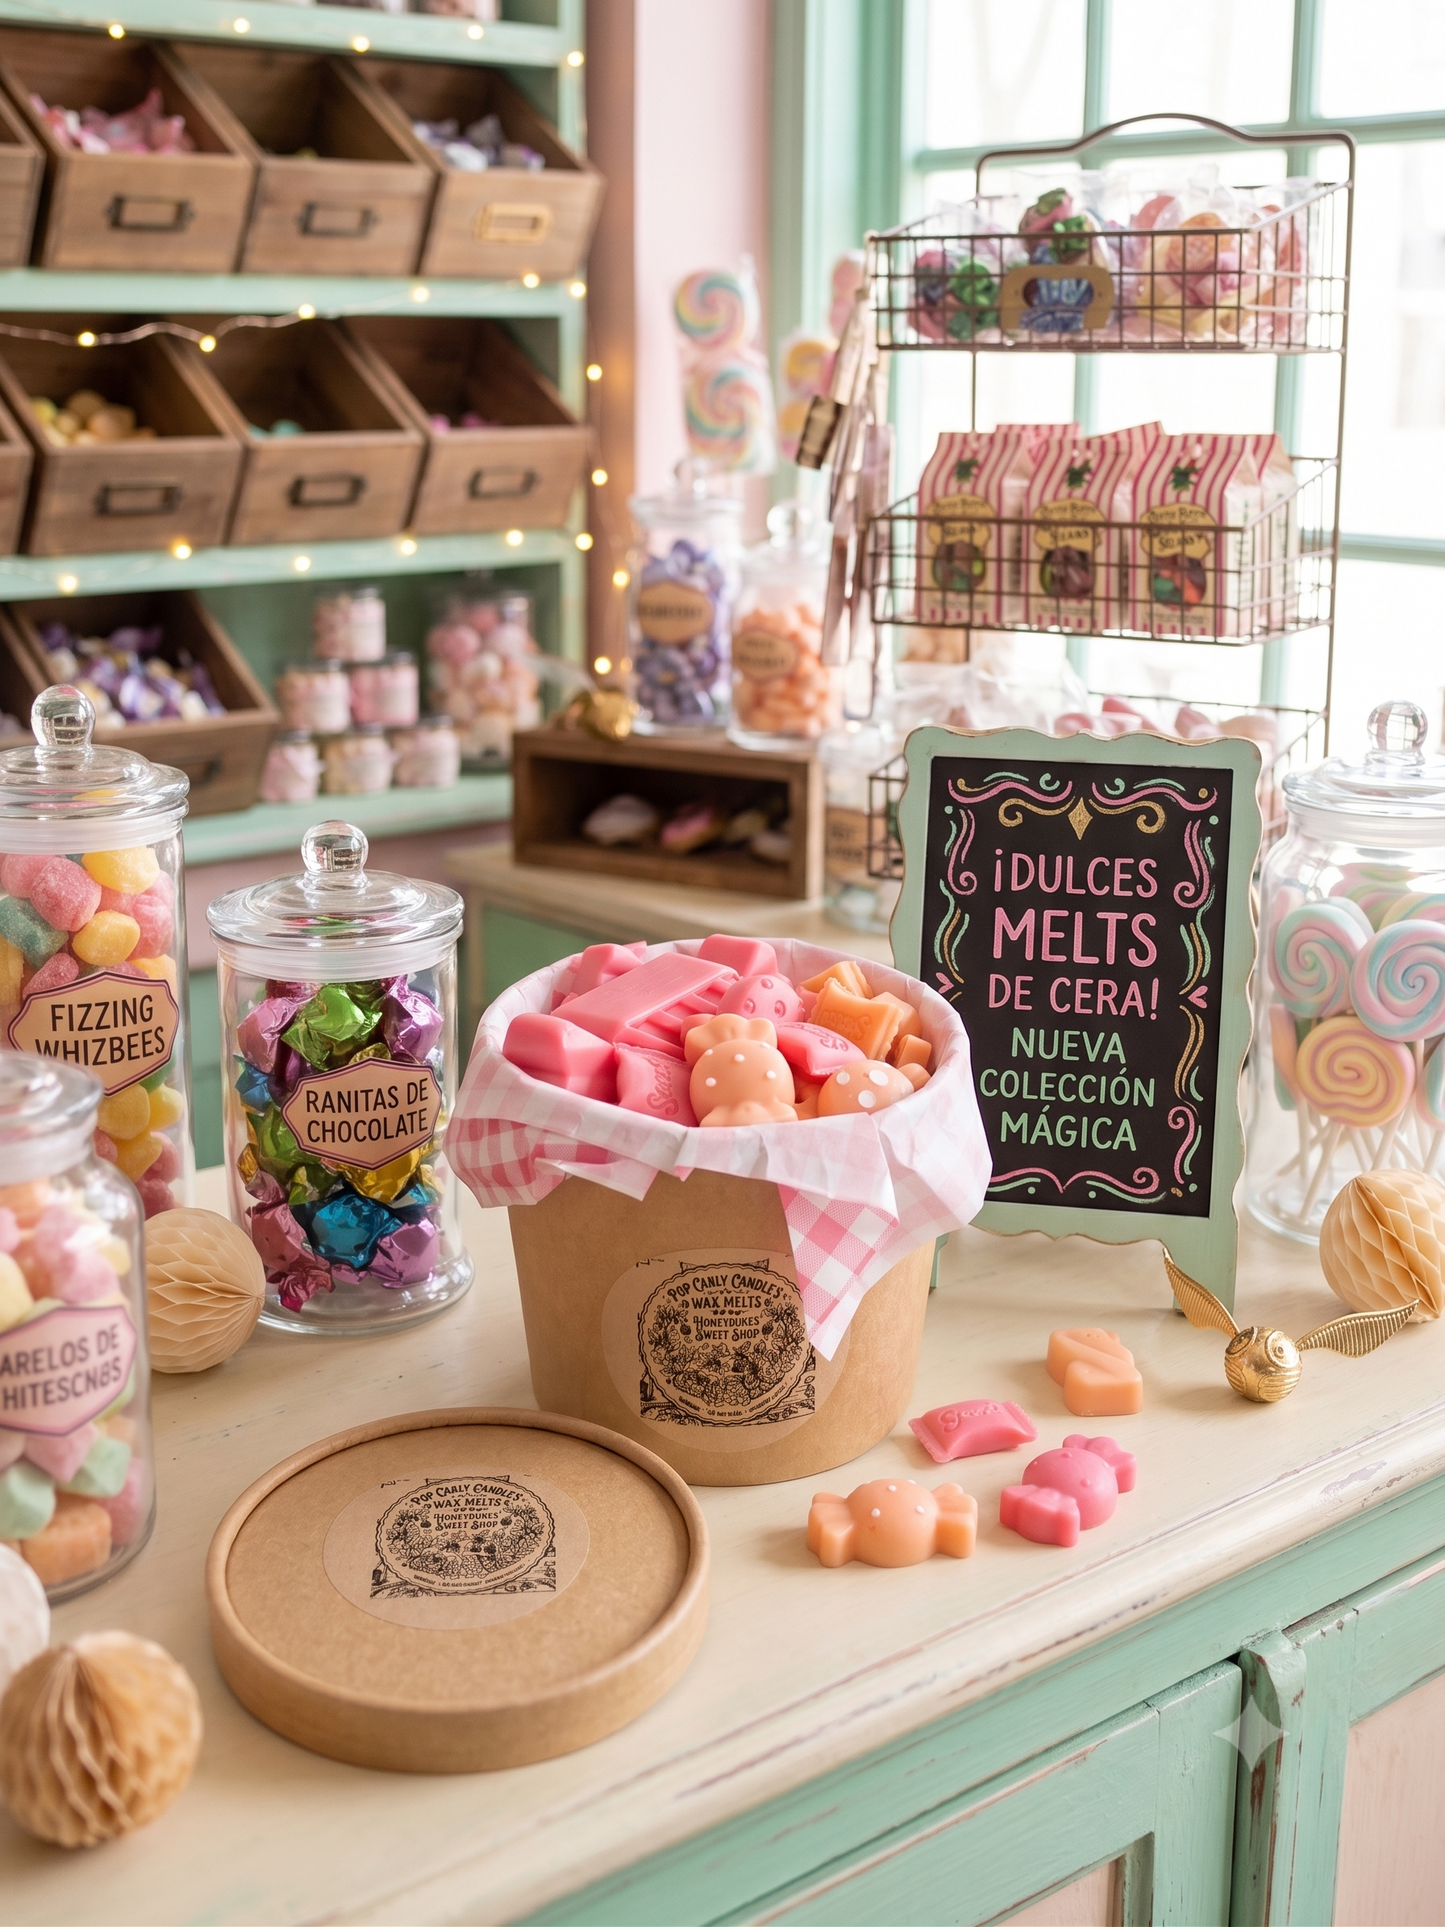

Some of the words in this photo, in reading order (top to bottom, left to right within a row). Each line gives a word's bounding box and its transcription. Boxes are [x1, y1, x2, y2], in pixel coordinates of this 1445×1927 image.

[994, 848, 1158, 898] ¡DULCES
[993, 907, 1157, 968] MELTS
[51, 994, 153, 1032] FIZZING
[988, 974, 1034, 1011] DE
[1049, 977, 1159, 1020] CERA!
[34, 1026, 165, 1066] WHIZBEES
[1011, 1027, 1127, 1064] NUEVA
[306, 1085, 399, 1114] RANITAS
[407, 1078, 429, 1105] DE
[980, 1067, 1155, 1107] COLECCIÓN
[307, 1108, 428, 1143] CHOCOLATE
[1000, 1105, 1137, 1151] MÁGICA
[667, 1282, 690, 1302] POP
[691, 1297, 721, 1309] WAX
[723, 1295, 761, 1308] MELTS
[693, 1315, 760, 1328] HONEYDUKES
[695, 1328, 729, 1341] SWEET
[732, 1328, 760, 1341] SHOP
[97, 1323, 120, 1356] DE
[410, 1491, 434, 1505] POP
[433, 1499, 461, 1509] WAX
[464, 1498, 501, 1507] MELTS
[435, 1521, 468, 1531] SWEET
[470, 1520, 498, 1530] SHOP
